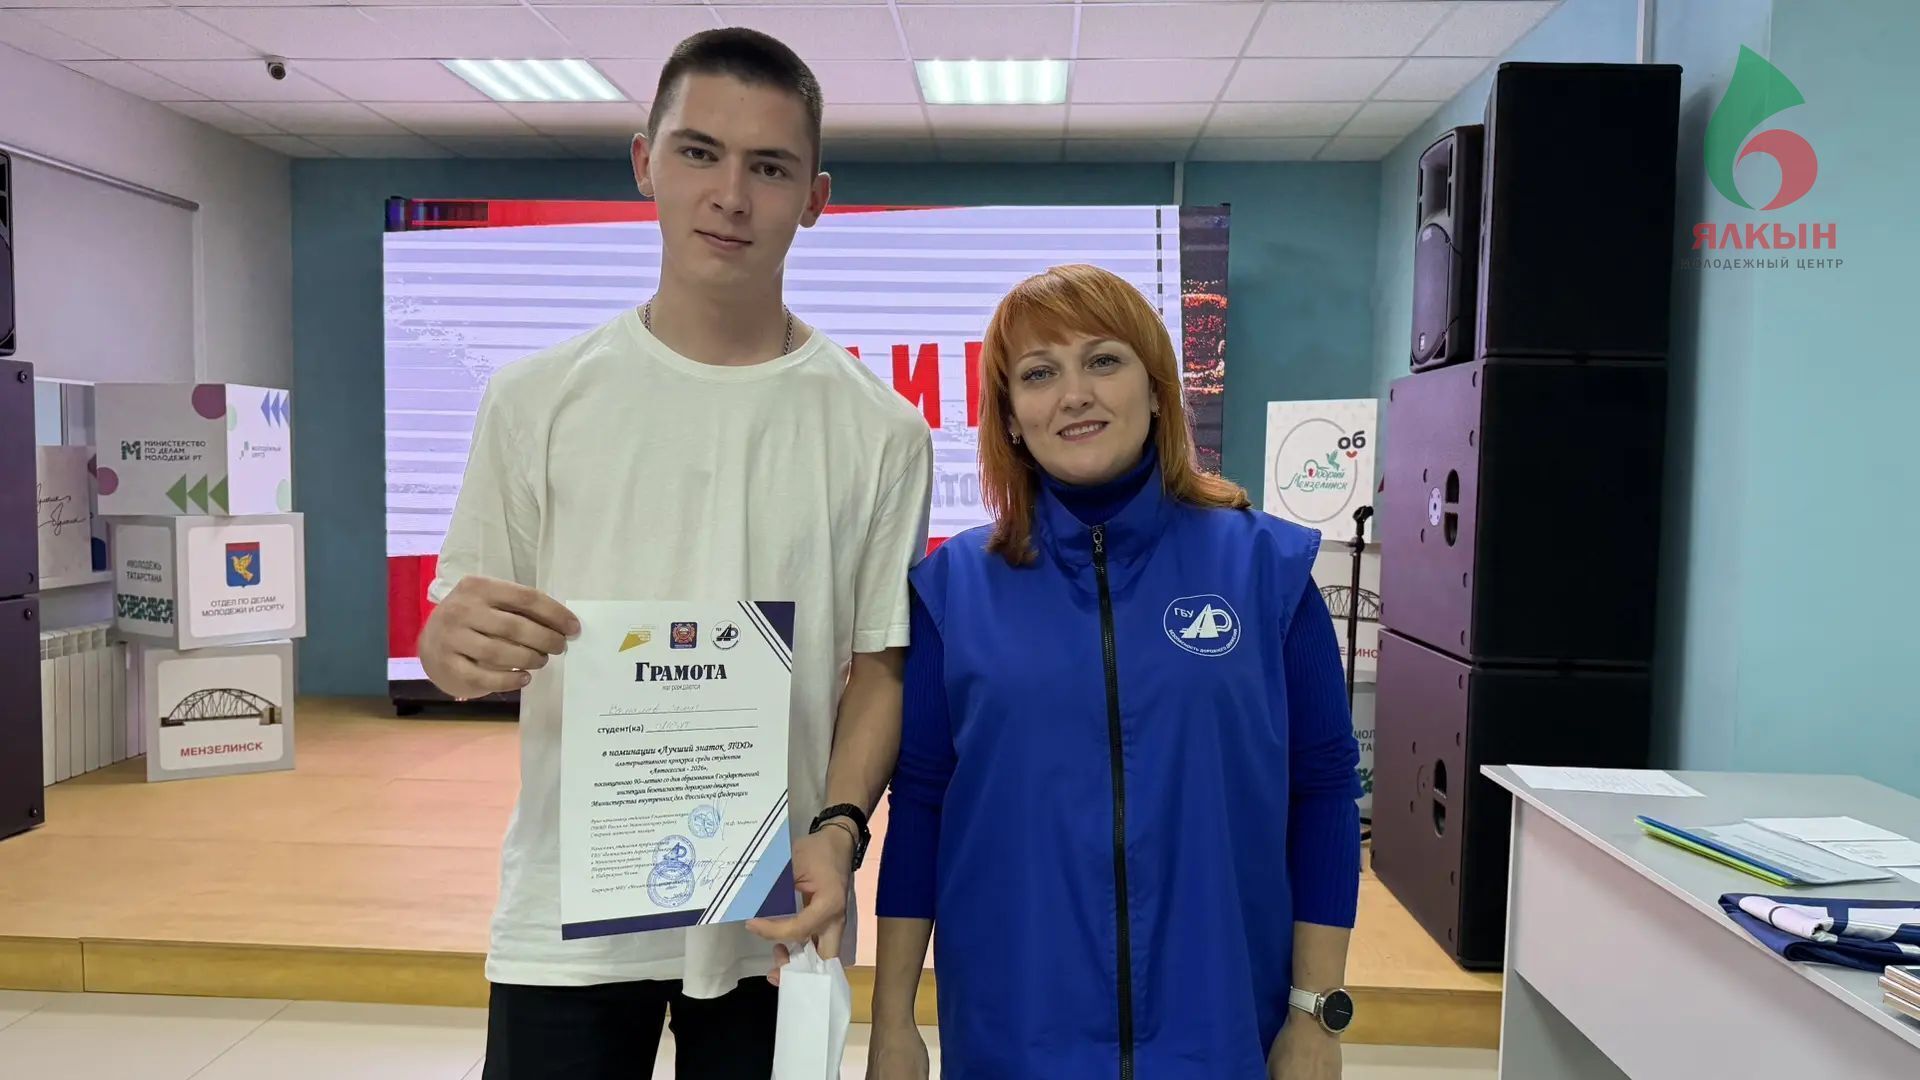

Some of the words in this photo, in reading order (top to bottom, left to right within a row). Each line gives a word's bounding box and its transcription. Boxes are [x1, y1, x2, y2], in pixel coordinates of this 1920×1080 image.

[159, 447, 185, 455] ДЕЛАМ
[126, 571, 163, 583] ТАТАРСТАНА
[210, 600, 236, 608] ОТДЕЛ
[237, 598, 249, 606] ПО
[251, 596, 276, 605] ДЕЛАМ
[202, 607, 247, 617] МОЛОДЕЖИ
[256, 604, 285, 613] СПОРТУ
[1173, 607, 1194, 618] ГБУ
[597, 724, 644, 735] студент(ка)
[180, 741, 263, 757] МЕНЗЕЛИНСК
[609, 748, 656, 757] номинации
